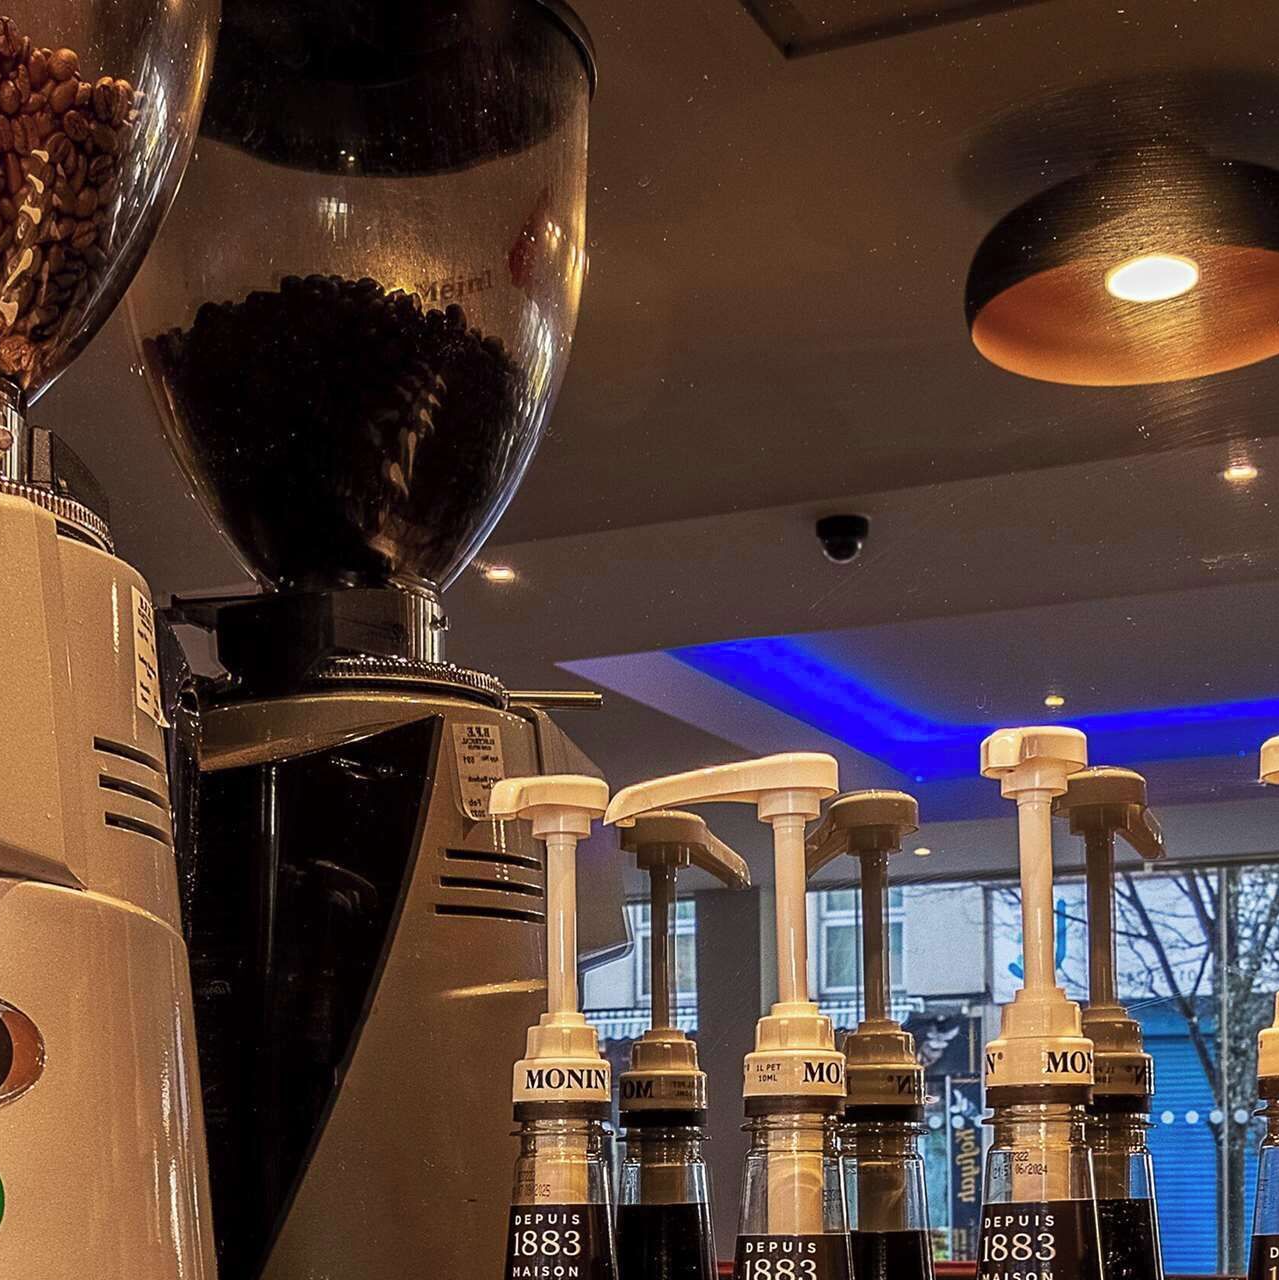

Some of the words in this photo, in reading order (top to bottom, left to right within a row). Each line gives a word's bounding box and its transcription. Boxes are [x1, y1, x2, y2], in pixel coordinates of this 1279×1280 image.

[756, 1064, 765, 1072] 1L
[766, 1063, 781, 1071] PET
[525, 1068, 606, 1089] MONIN
[758, 1074, 778, 1082] 10ML
[515, 1213, 580, 1225] DEPUIS
[985, 1215, 1054, 1228] DEPUIS
[514, 1230, 580, 1256] 1883
[746, 1242, 816, 1253] DEPUIS
[983, 1233, 1056, 1262] 1883
[513, 1266, 578, 1277] MAISON
